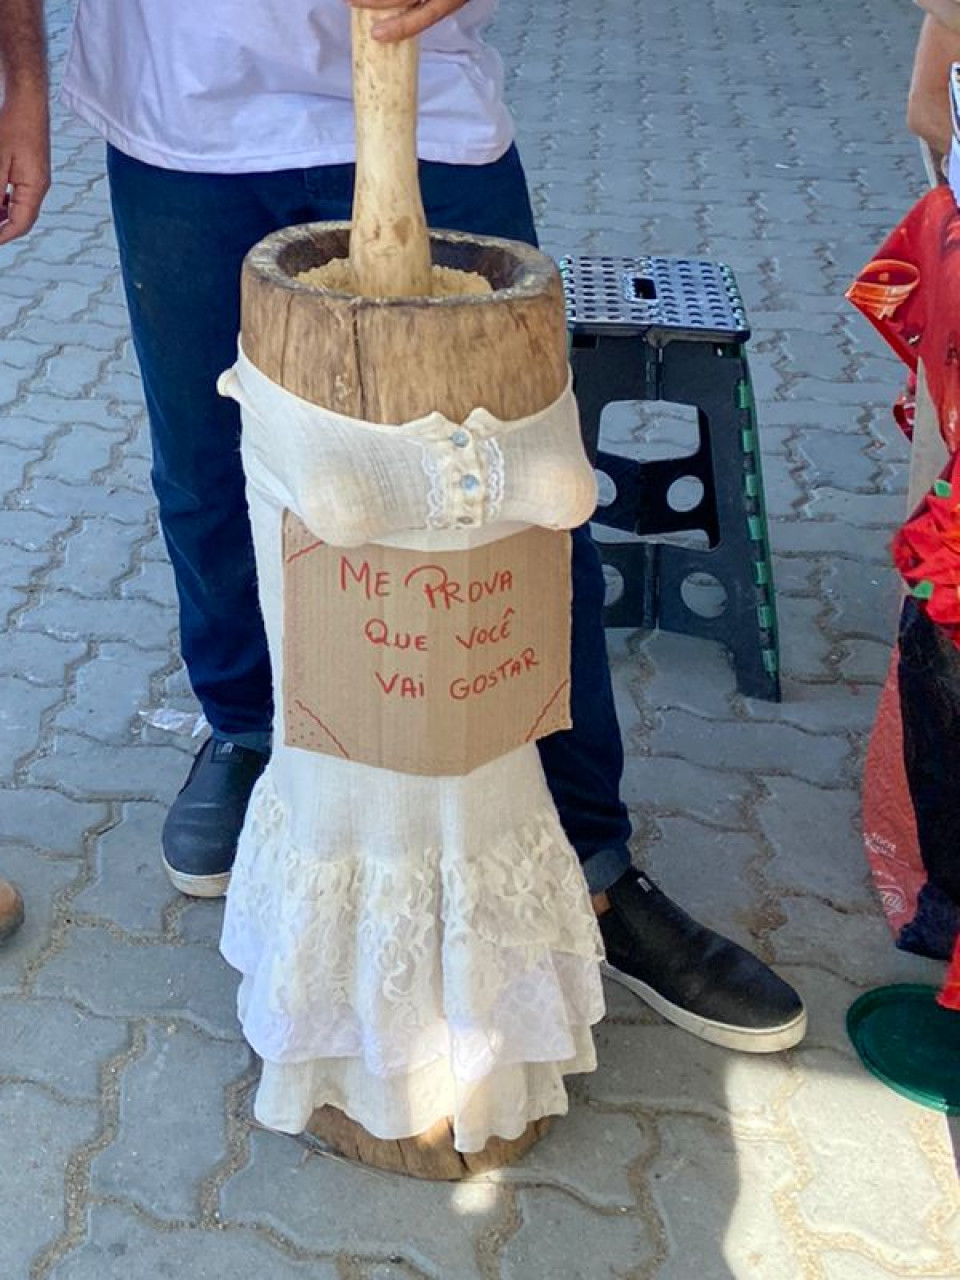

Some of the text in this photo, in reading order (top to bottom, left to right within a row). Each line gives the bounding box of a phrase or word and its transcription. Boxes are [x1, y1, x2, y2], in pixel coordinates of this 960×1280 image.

[340, 556, 513, 610] ME PROVA
[364, 607, 515, 652] QUE VOCÊ
[449, 647, 540, 700] GOSTAR
